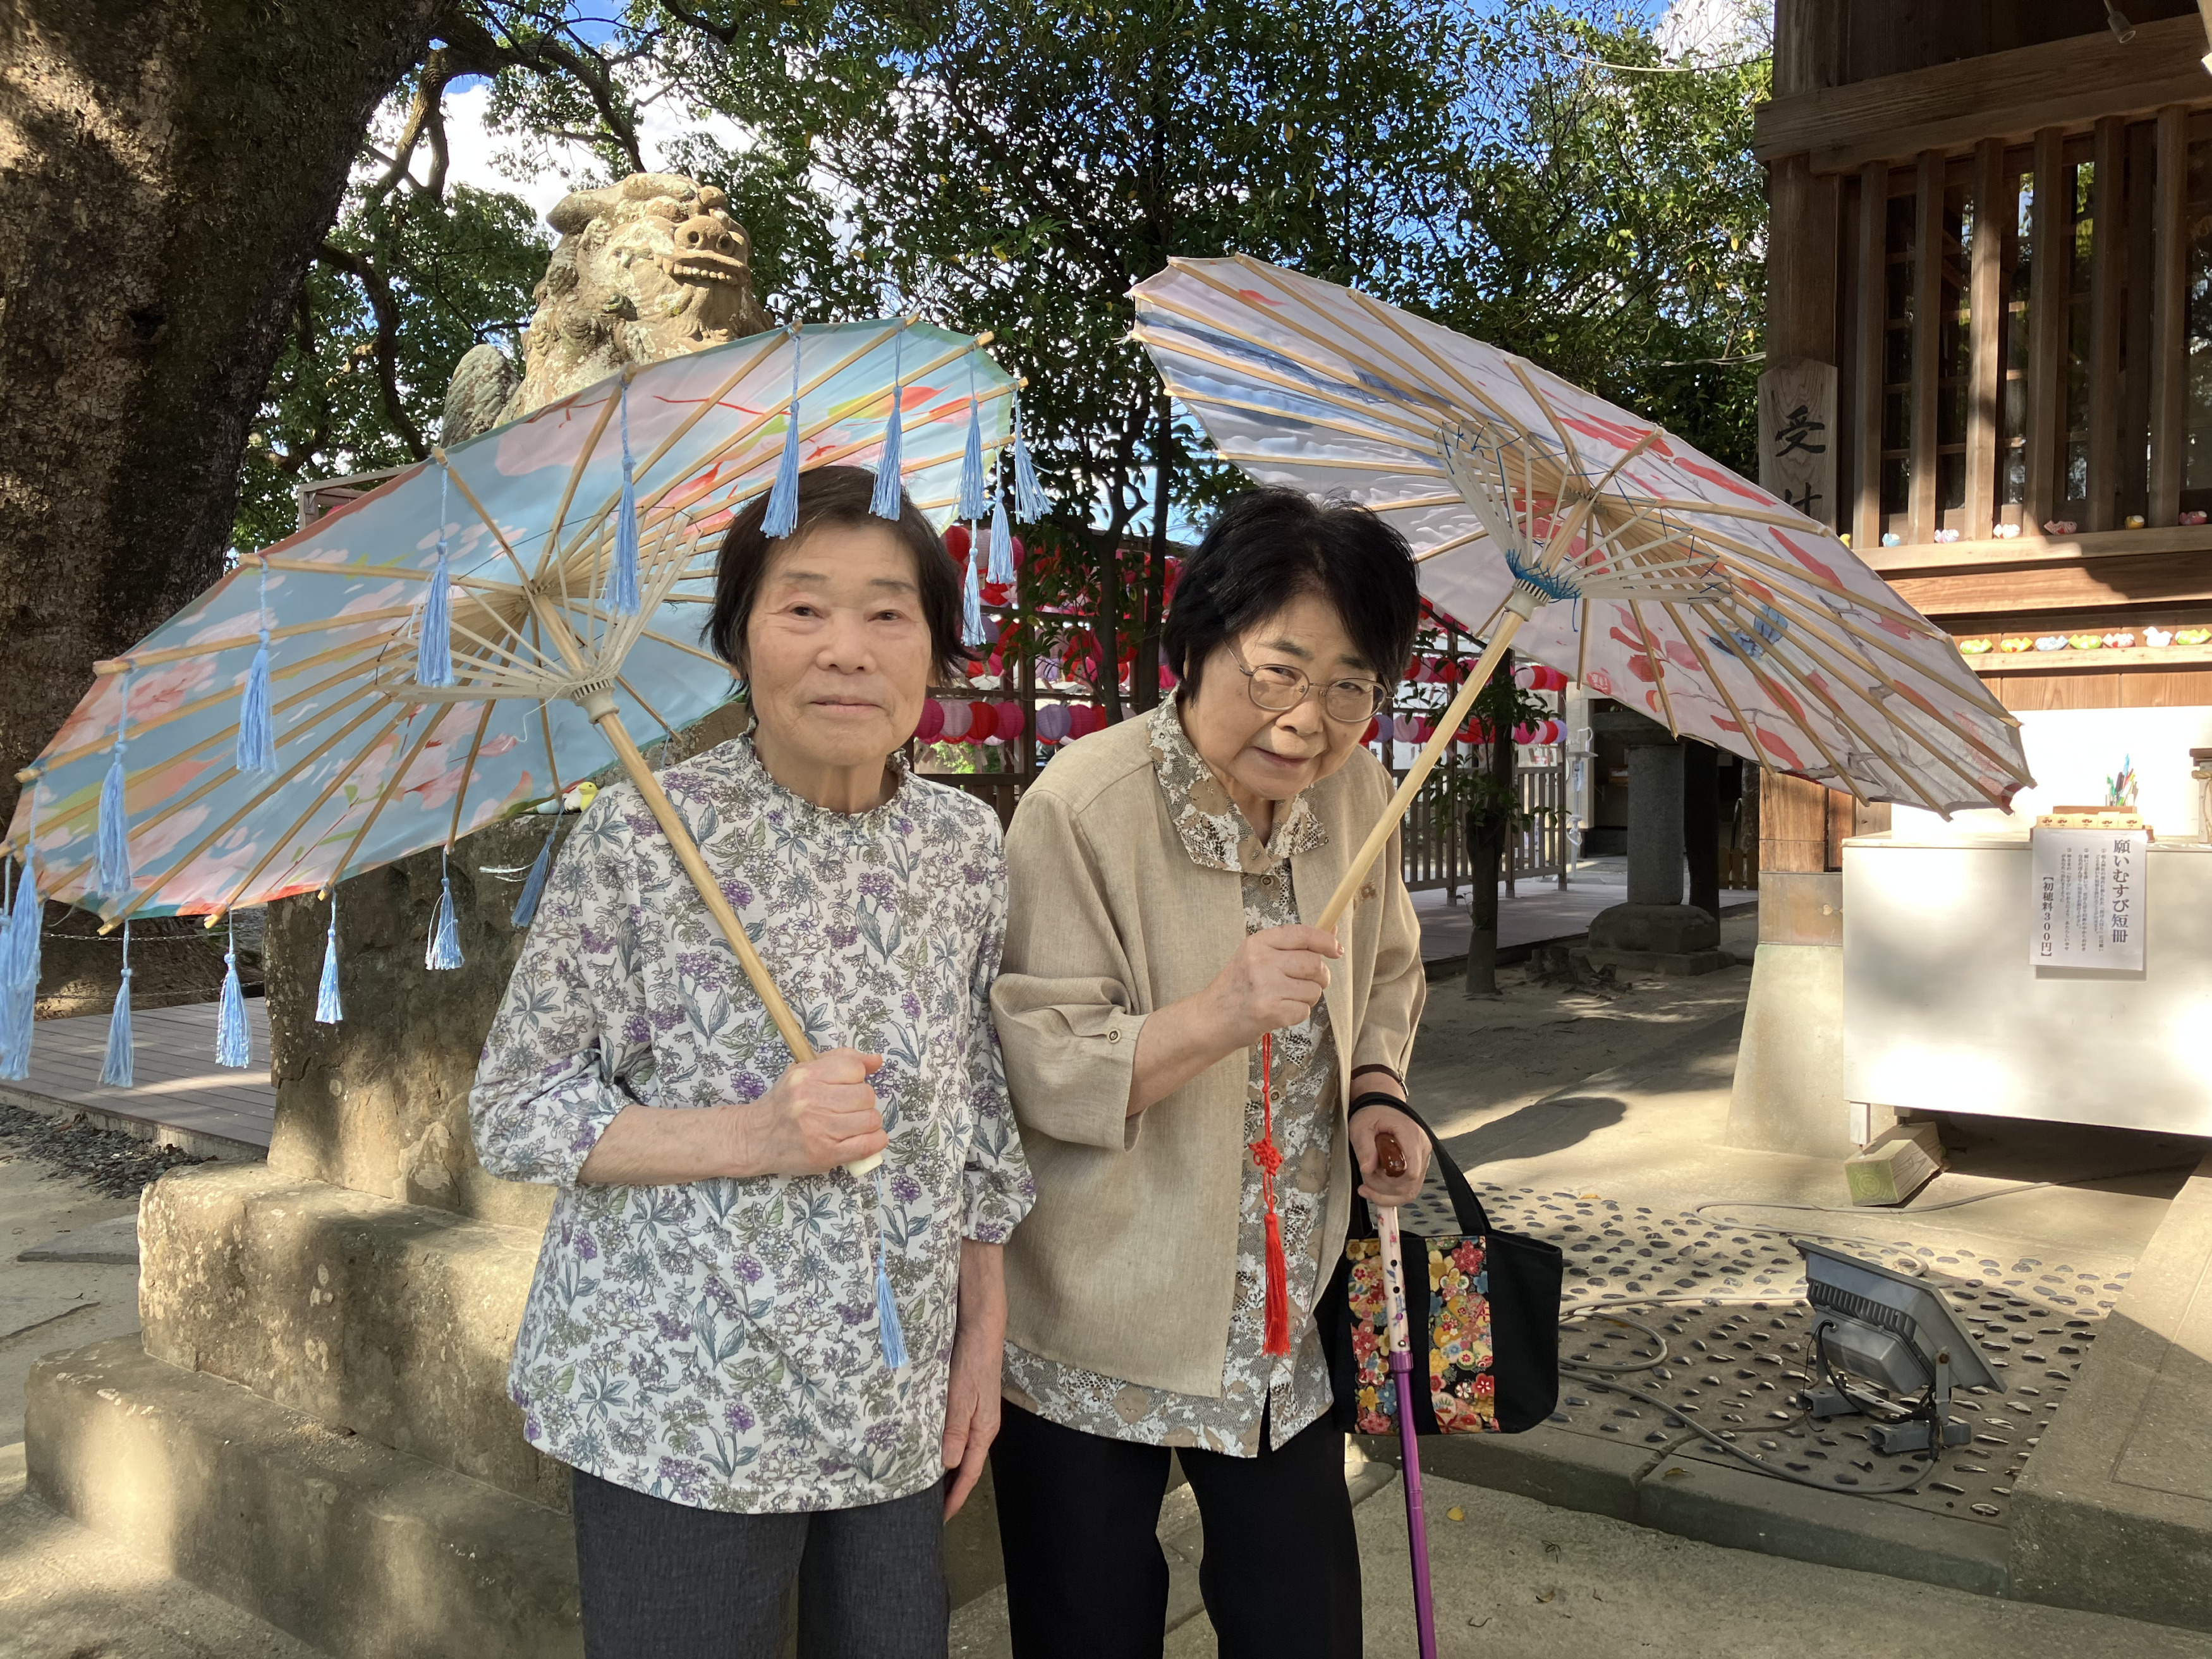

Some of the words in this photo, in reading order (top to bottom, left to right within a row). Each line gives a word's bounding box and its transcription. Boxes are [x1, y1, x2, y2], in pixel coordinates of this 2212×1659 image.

[2111, 839, 2130, 943] 願いむすび短冊
